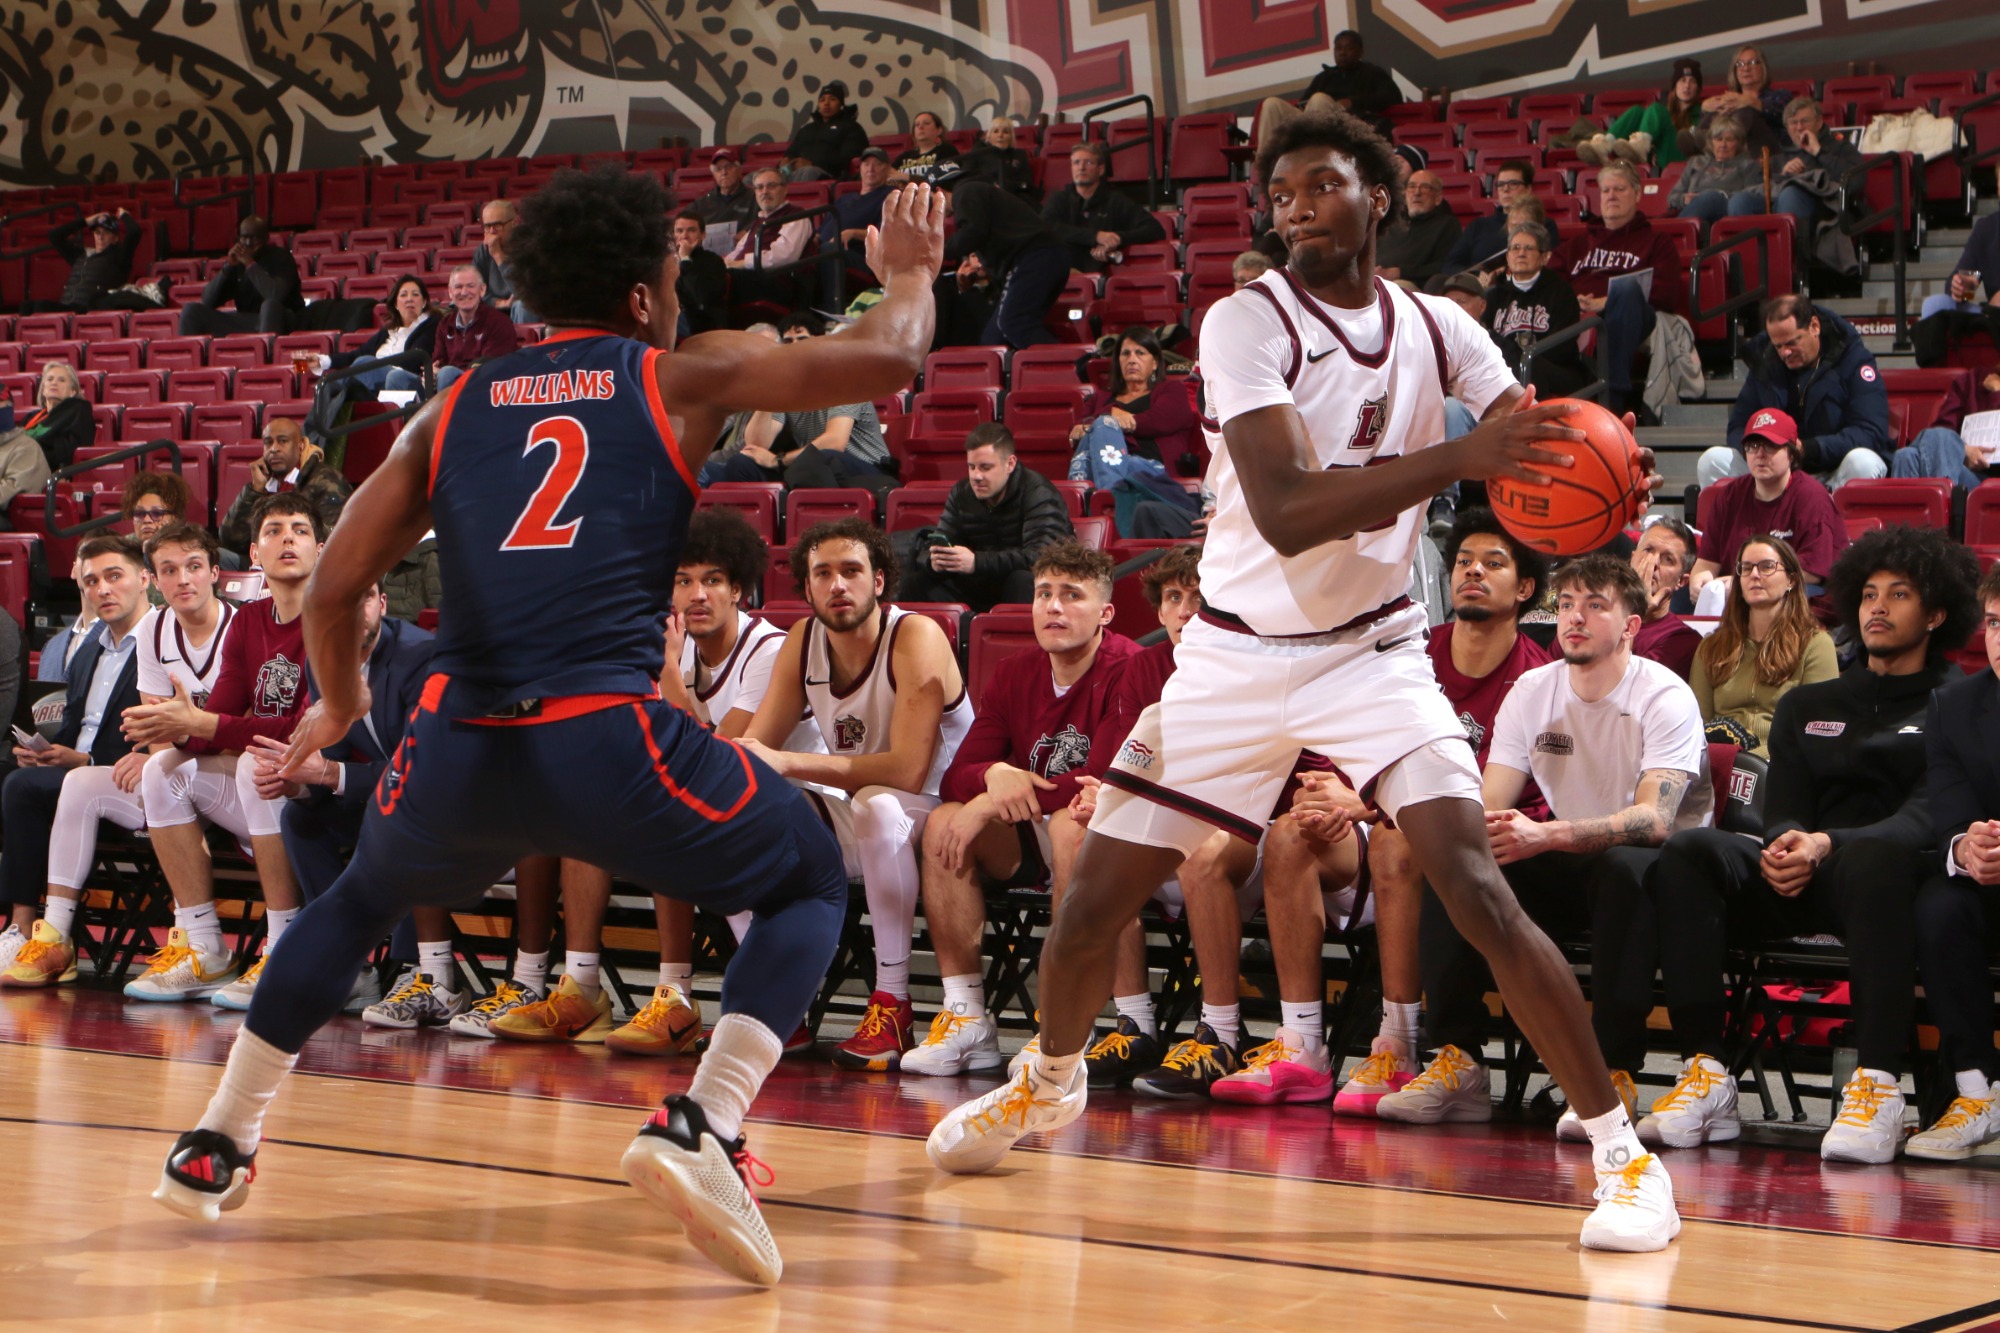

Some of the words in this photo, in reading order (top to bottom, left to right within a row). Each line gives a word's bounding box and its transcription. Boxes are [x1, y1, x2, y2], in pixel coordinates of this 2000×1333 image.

[556, 85, 584, 104] TM
[1850, 321, 1896, 335] ection
[490, 369, 615, 407] WILLIAMS
[498, 415, 589, 551] 2
